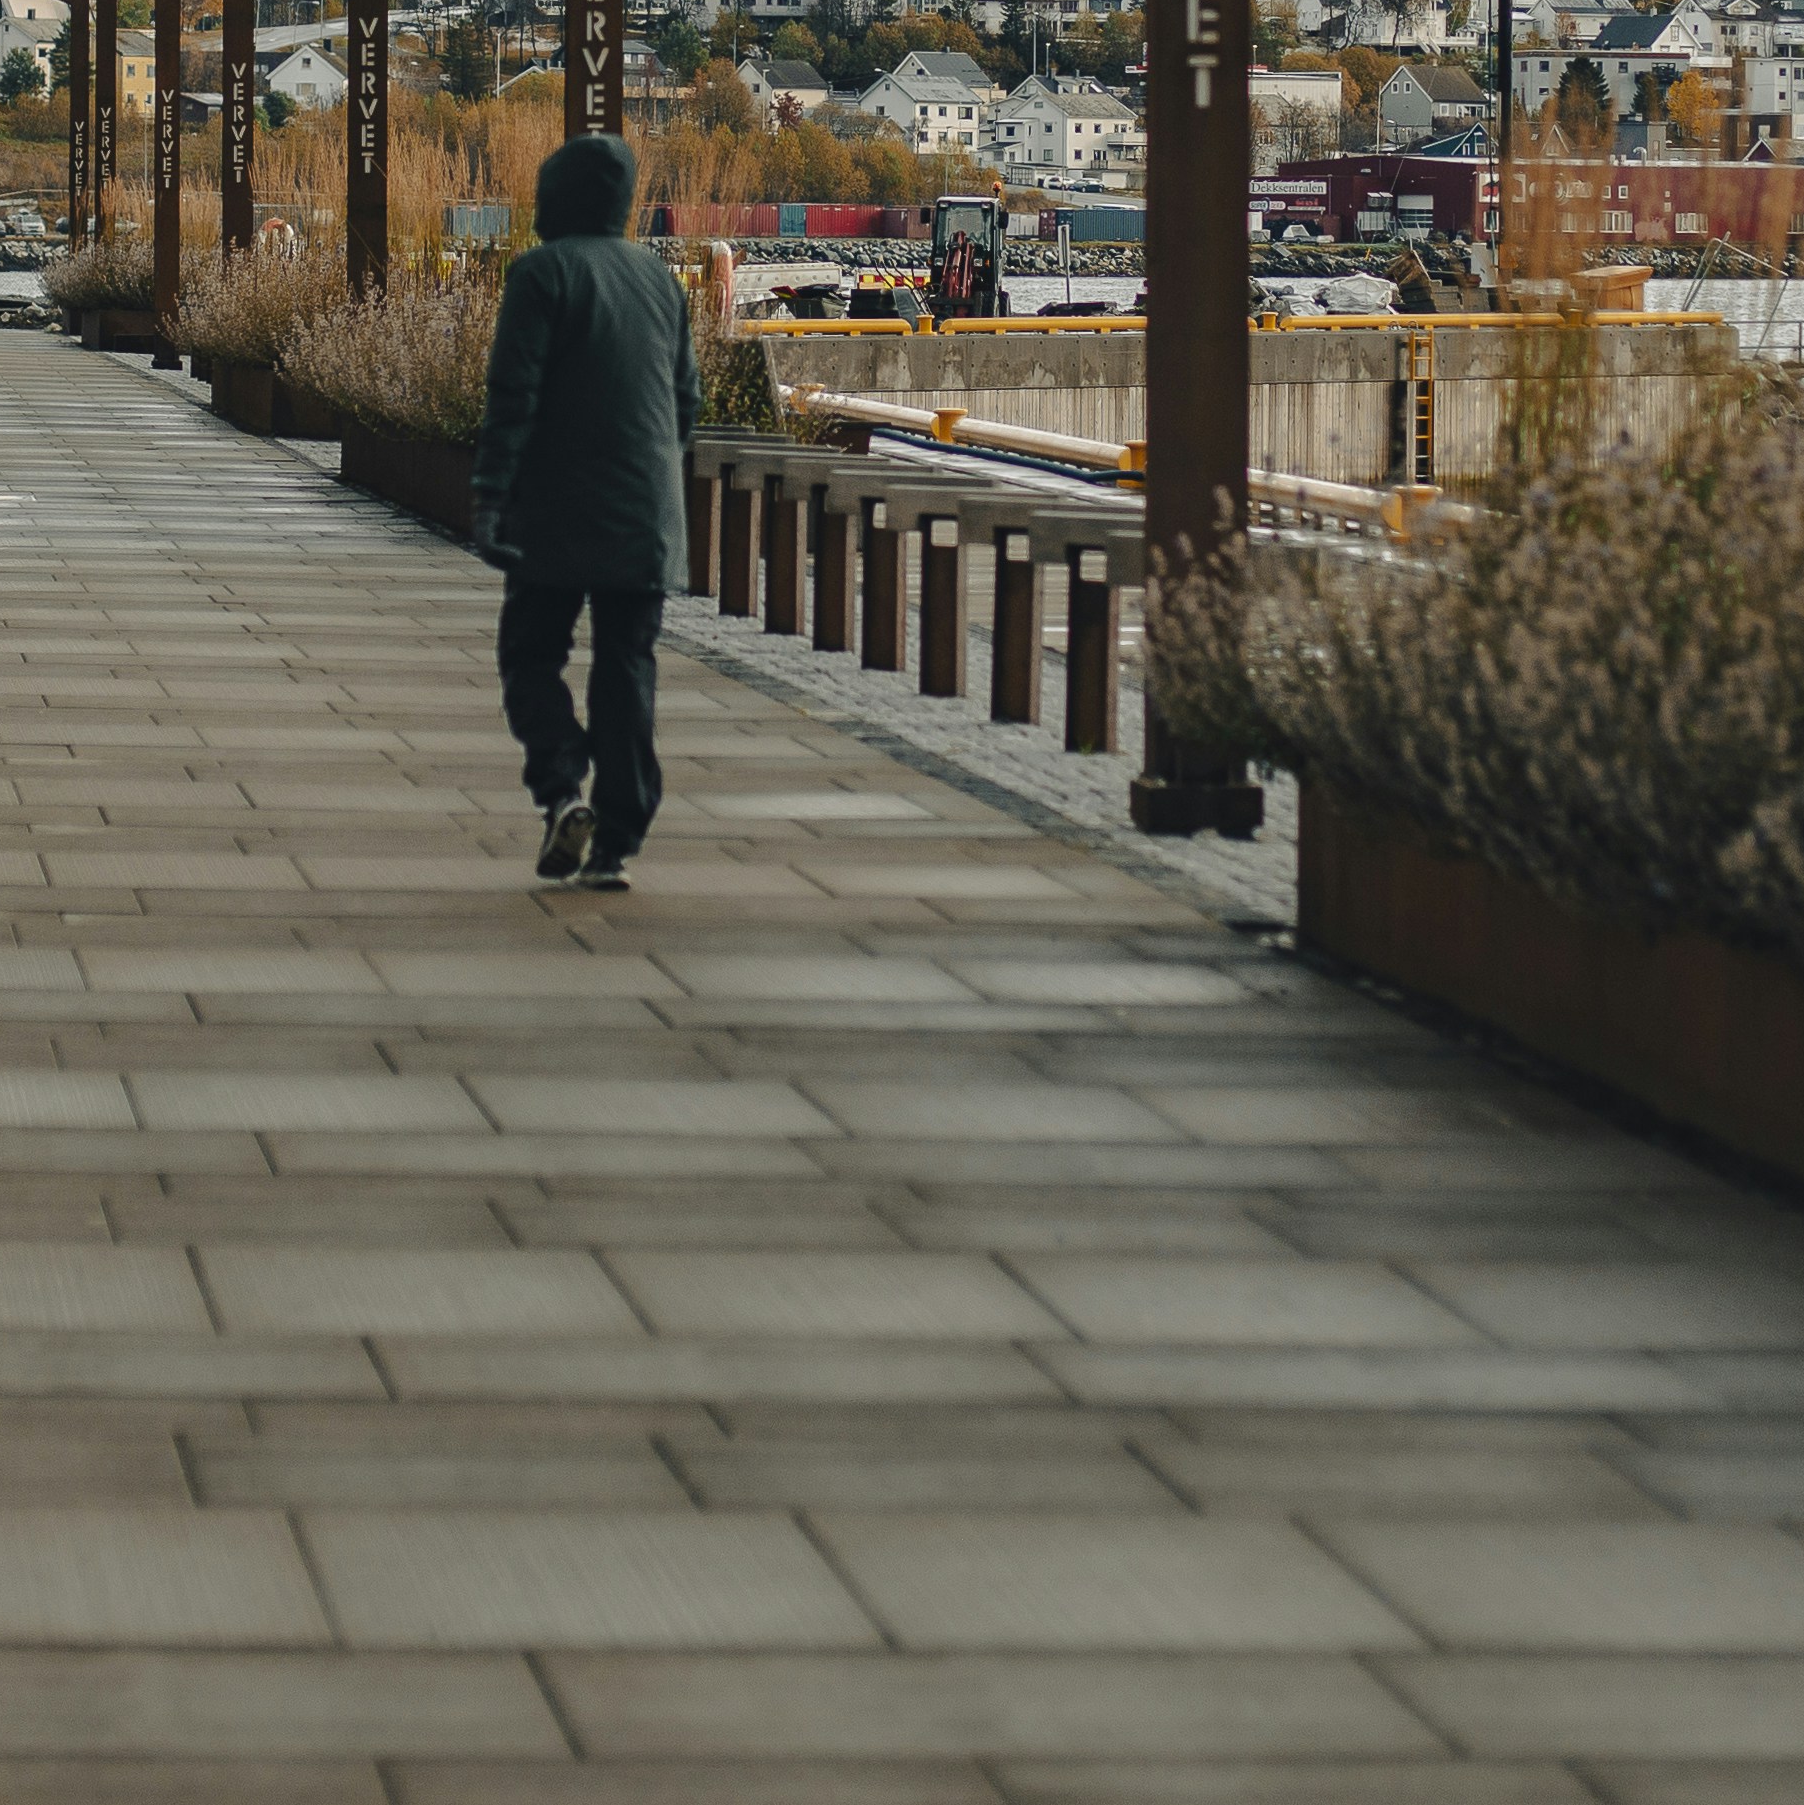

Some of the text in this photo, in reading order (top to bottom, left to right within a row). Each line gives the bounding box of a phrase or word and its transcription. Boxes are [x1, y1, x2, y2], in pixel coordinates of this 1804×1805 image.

[161, 89, 175, 188] VERVET
[231, 63, 247, 184] VERVET
[358, 17, 379, 174] VERVET
[74, 121, 85, 196] VERVET
[100, 107, 111, 190] VERVET
[1251, 182, 1324, 193] Dekksentralen
